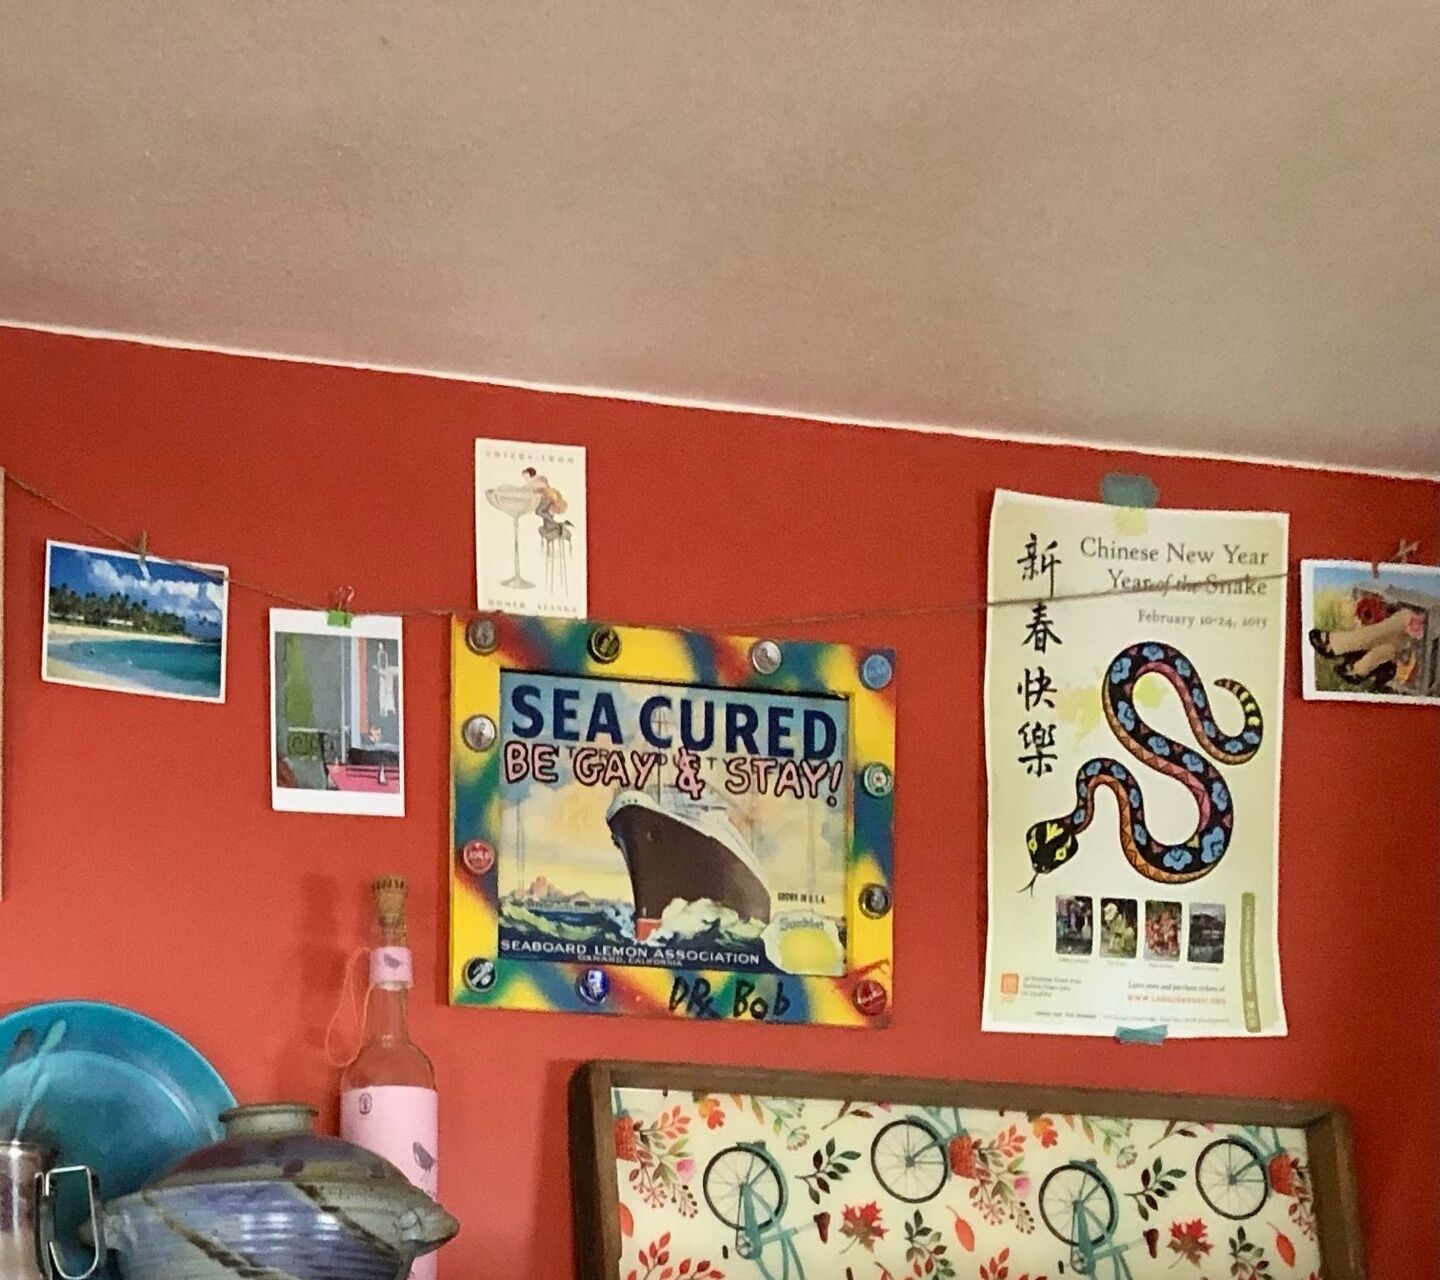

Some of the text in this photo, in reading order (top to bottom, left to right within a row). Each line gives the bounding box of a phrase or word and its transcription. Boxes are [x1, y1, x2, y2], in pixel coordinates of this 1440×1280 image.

[1080, 536, 1269, 565] Chinese New Year
[1109, 569, 1151, 592] Year
[1206, 573, 1267, 596] Snake
[1138, 609, 1195, 627] February
[511, 685, 837, 761] SEA CURED
[504, 740, 559, 784] BE
[573, 747, 656, 790] GAY
[675, 747, 706, 800] &
[725, 756, 843, 807] STAY!
[500, 939, 760, 965] SEABOARD LEMON ASSOCIATION
